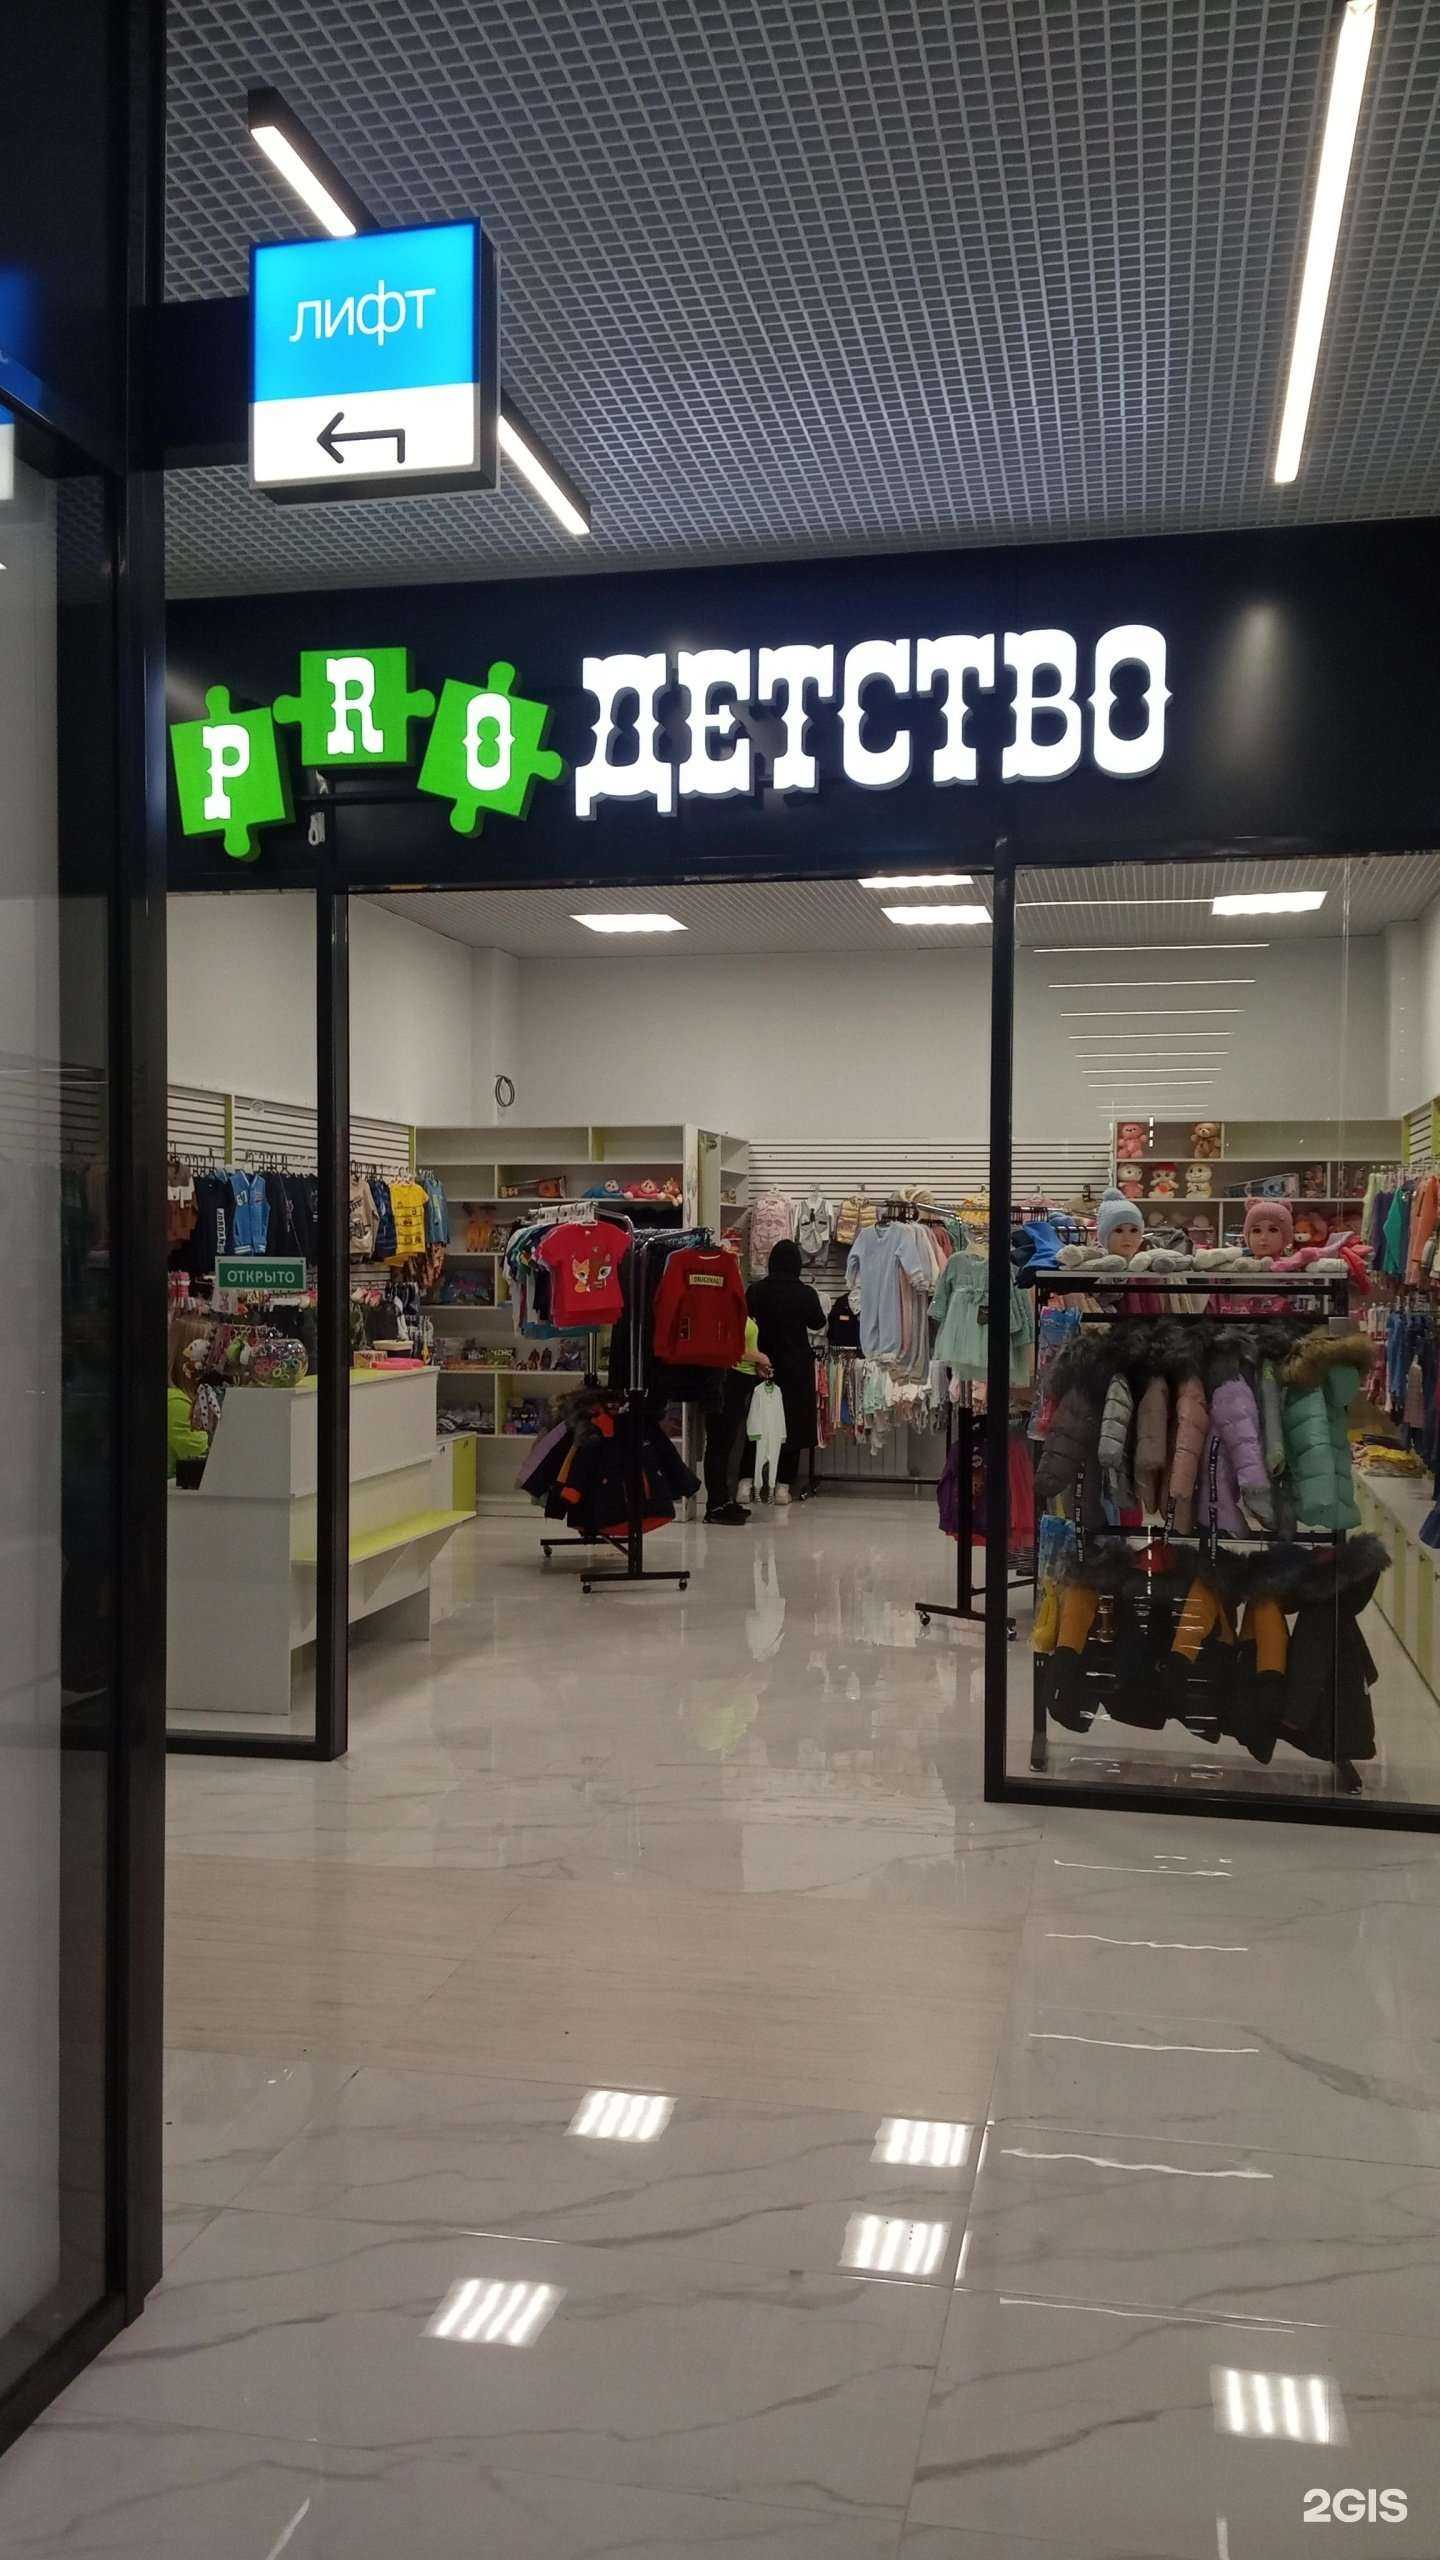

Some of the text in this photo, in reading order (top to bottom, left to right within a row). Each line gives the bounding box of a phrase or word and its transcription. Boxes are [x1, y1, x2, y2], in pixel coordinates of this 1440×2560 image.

[202, 624, 1173, 821] PRO ДЕТСТВО
[227, 1270, 295, 1283] ОТКРЫТО
